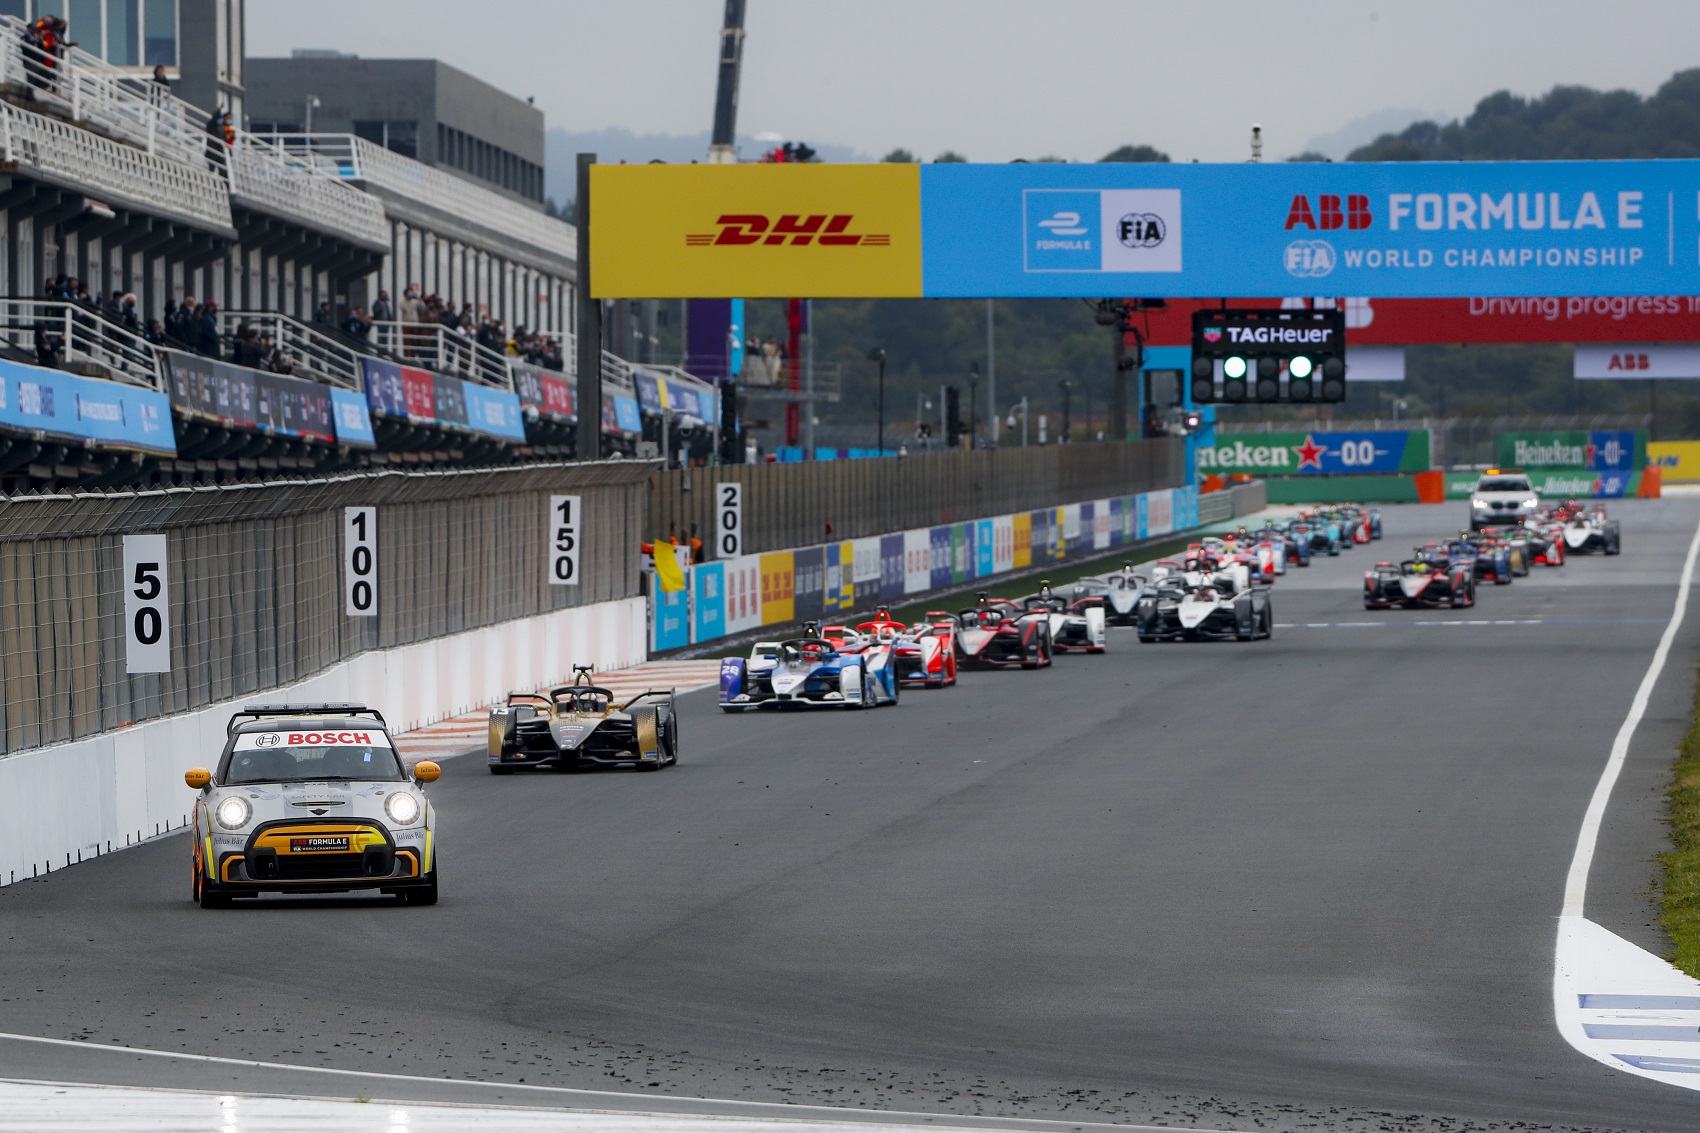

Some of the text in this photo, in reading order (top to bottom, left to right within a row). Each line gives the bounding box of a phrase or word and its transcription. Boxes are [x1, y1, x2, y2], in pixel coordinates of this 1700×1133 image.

[1284, 191, 1644, 231] ABB FORMULA E
[714, 215, 863, 246] DHL
[1036, 240, 1092, 250] FORMULA E
[1344, 249, 1434, 268] WORLD
[1444, 247, 1644, 267] CHAMPIONSHIP
[1469, 296, 1560, 320] Driving
[1567, 295, 1681, 319] progress
[1607, 353, 1650, 371] ABB
[1197, 440, 1290, 467] neken
[1514, 439, 1583, 466] Heineken
[1542, 477, 1591, 495] Heineken
[722, 486, 737, 554] 200
[555, 500, 575, 581] 150
[351, 512, 372, 611] 100
[133, 562, 162, 646] 50
[721, 665, 740, 676] 28
[287, 732, 372, 745] BOSCH
[213, 837, 243, 846] Julius Bär
[308, 838, 342, 846] FORMULA
[396, 832, 415, 841] Julius
